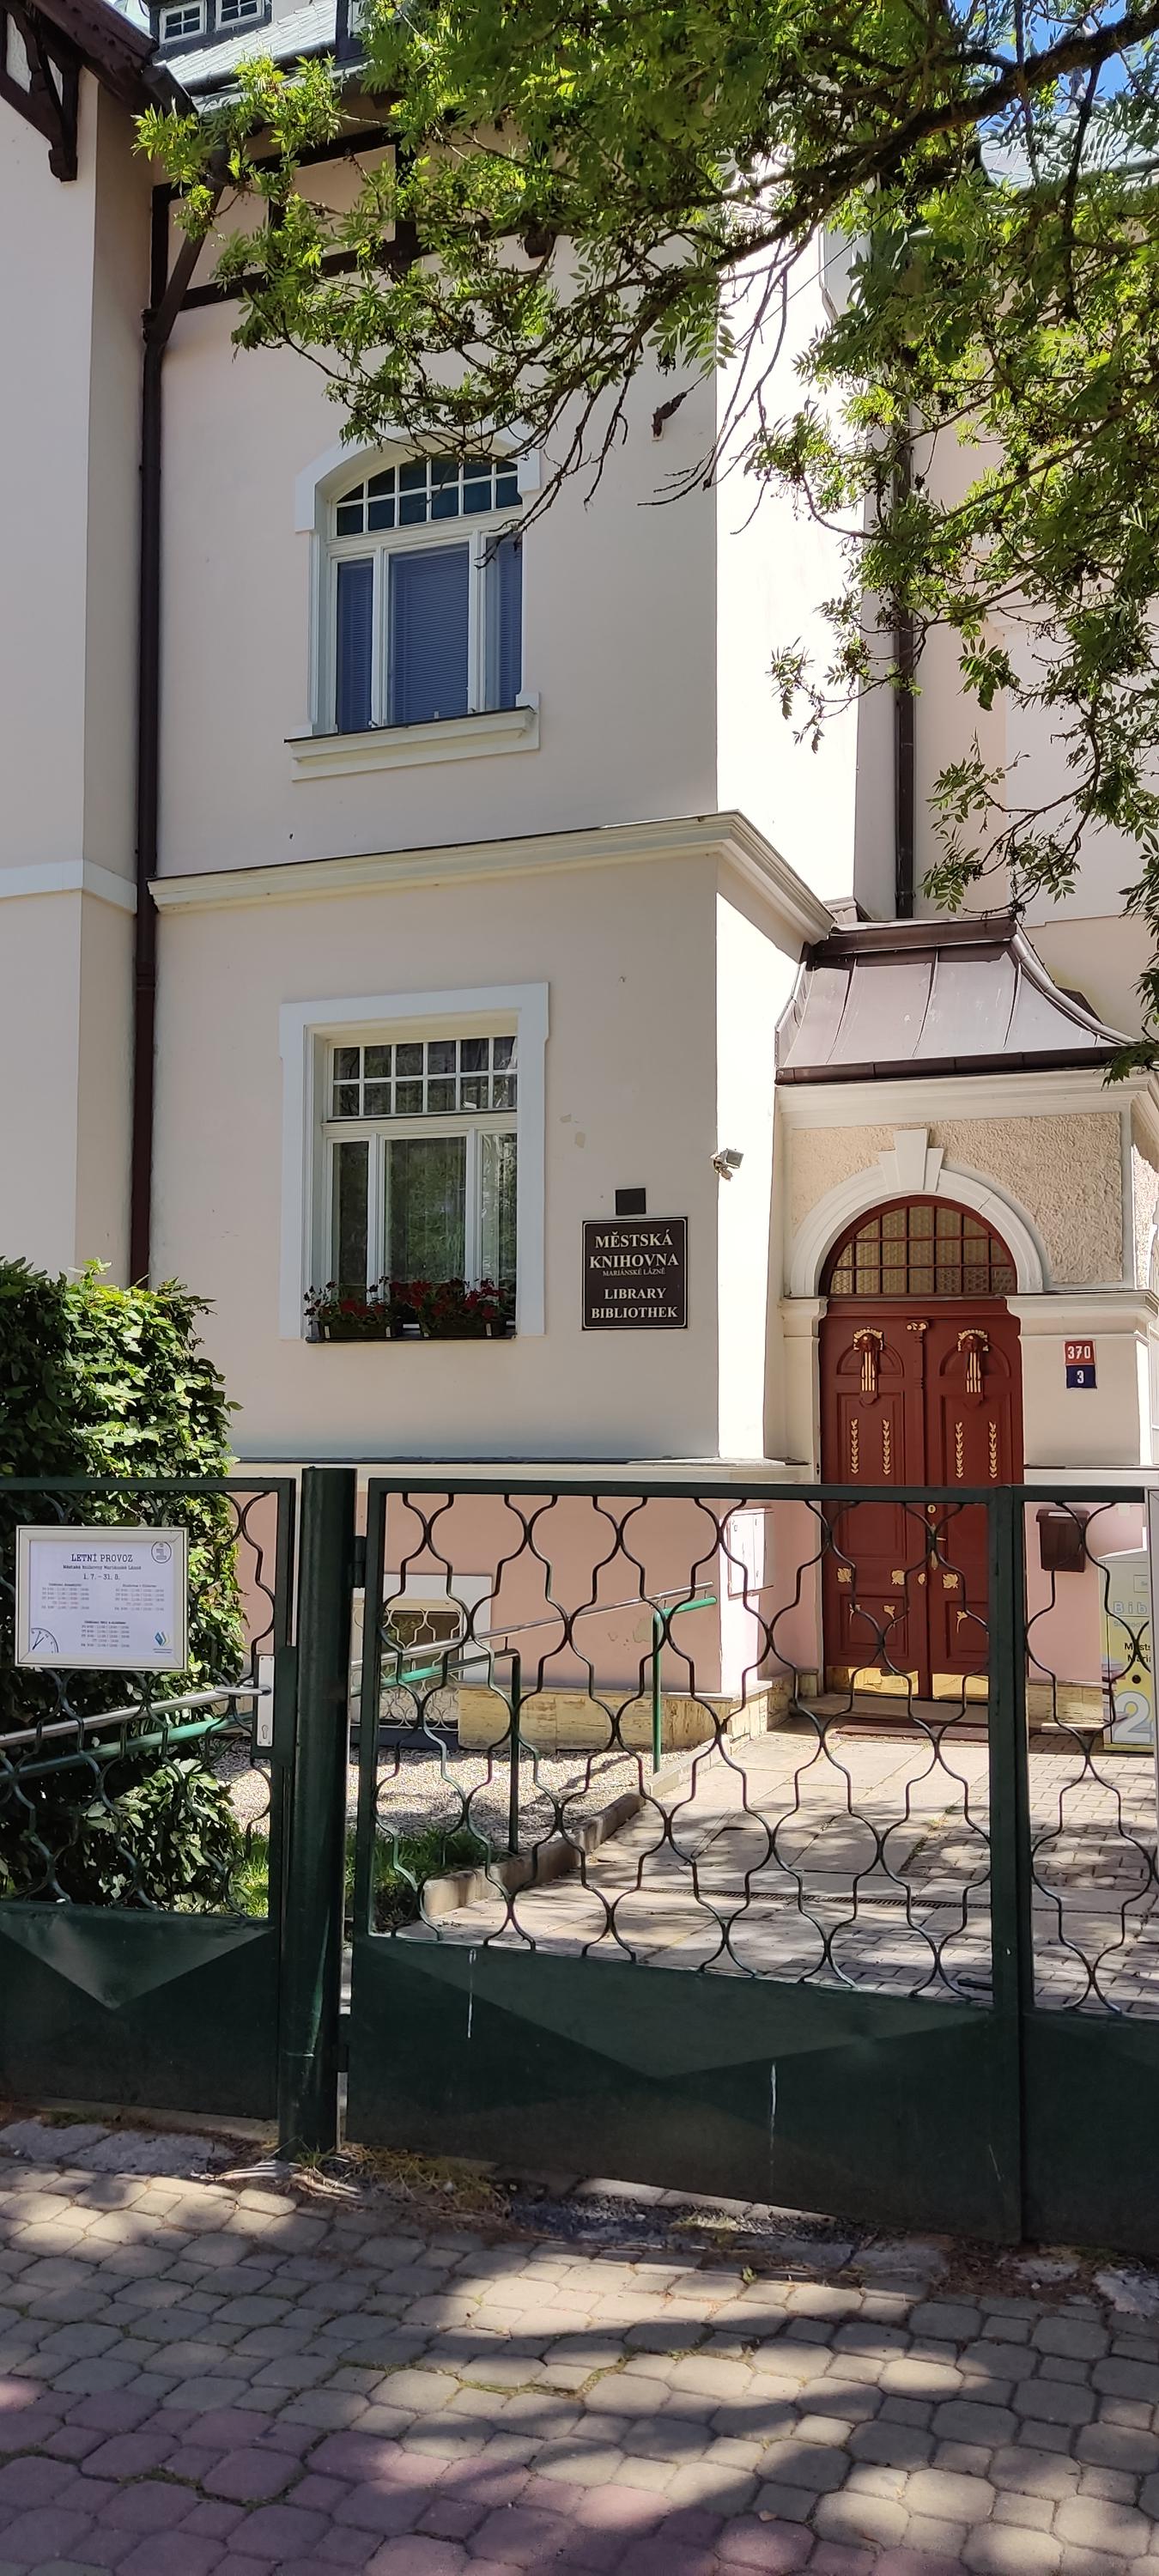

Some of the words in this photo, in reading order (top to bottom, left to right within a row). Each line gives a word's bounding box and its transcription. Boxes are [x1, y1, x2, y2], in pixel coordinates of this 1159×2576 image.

[595, 1229, 673, 1249] MĚSTSKÁ
[590, 1253, 679, 1269] KNIHOVNA
[603, 1268, 642, 1277] MARIÁNSKÉ
[643, 1267, 666, 1275] LÁZNĚ
[604, 1288, 666, 1300] LIBRARY
[591, 1306, 678, 1319] BIBLIOTHEK
[1067, 1346, 1091, 1359] 370
[1077, 1370, 1084, 1384] 3
[71, 1553, 97, 1562] LETNÍ
[100, 1554, 133, 1563] PROVOZ
